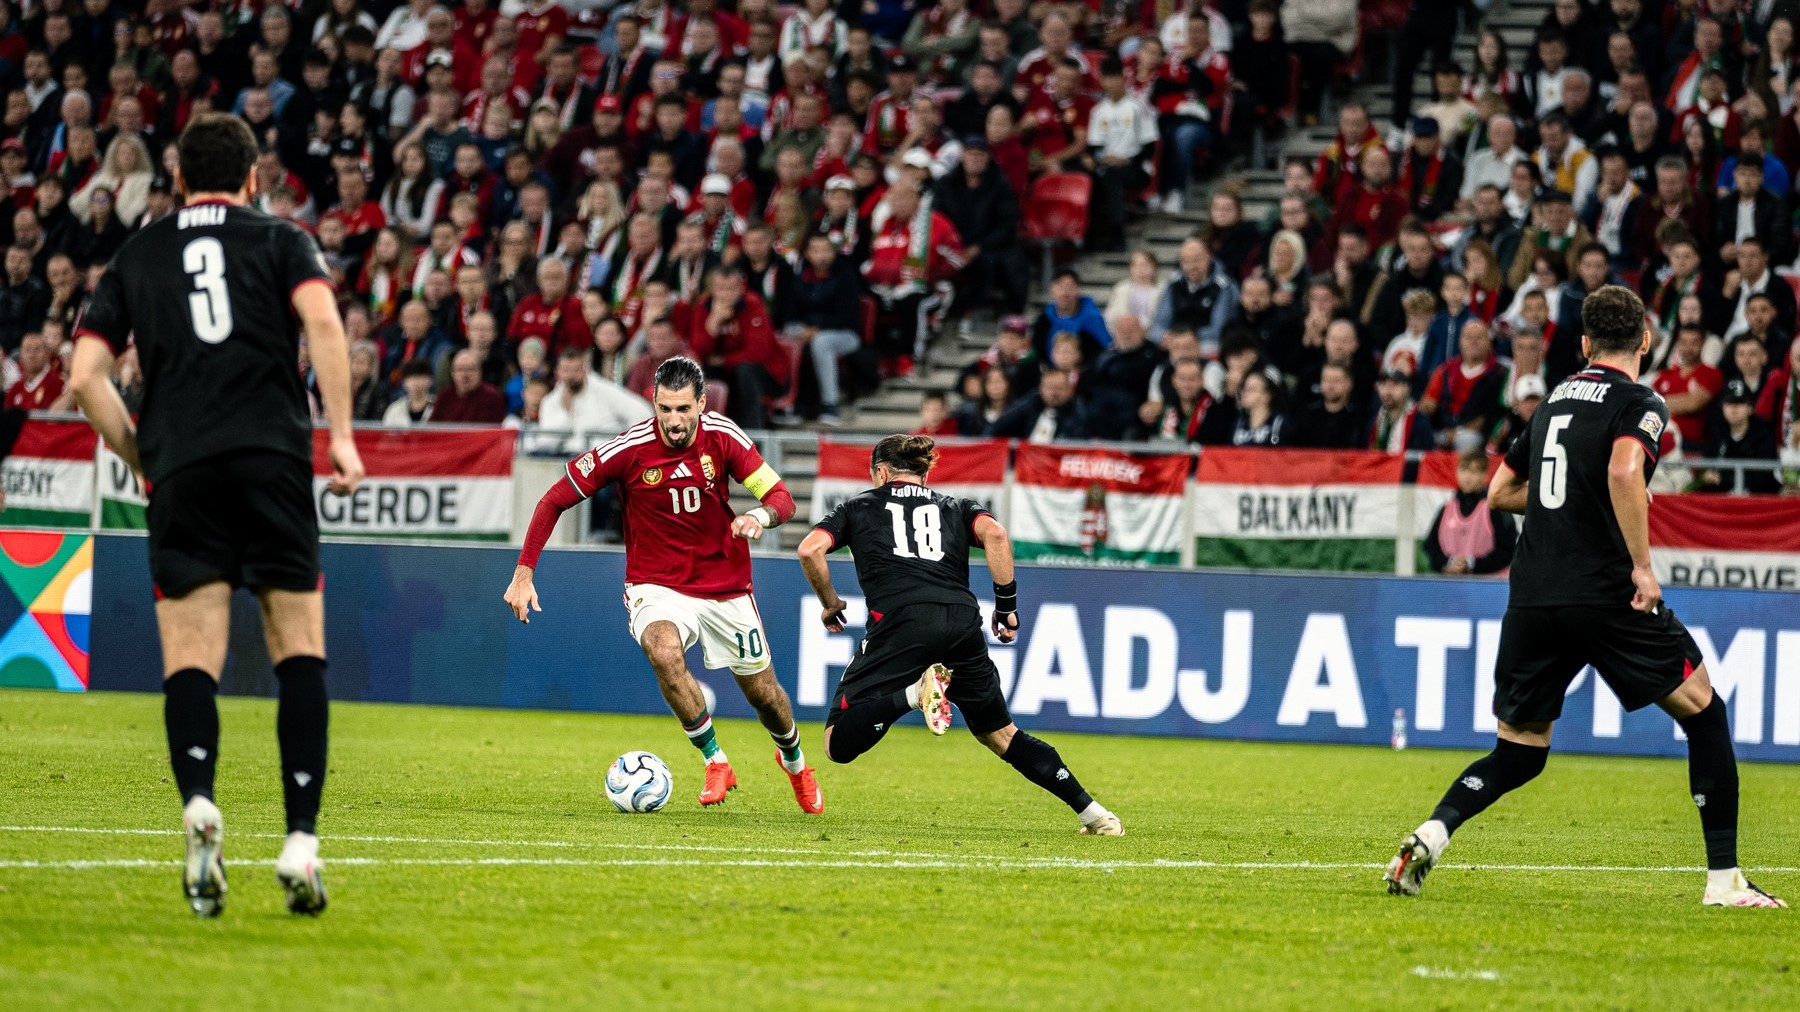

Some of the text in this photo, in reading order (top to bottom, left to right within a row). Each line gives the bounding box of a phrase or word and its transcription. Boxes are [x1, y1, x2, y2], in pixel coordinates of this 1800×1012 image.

[182, 236, 233, 345] 3
[1539, 414, 1574, 510] 5
[668, 486, 701, 515] 10
[1238, 487, 1357, 532] BALKÁNY
[885, 502, 945, 562] 18
[735, 628, 763, 659] 10
[1276, 613, 1368, 728] A
